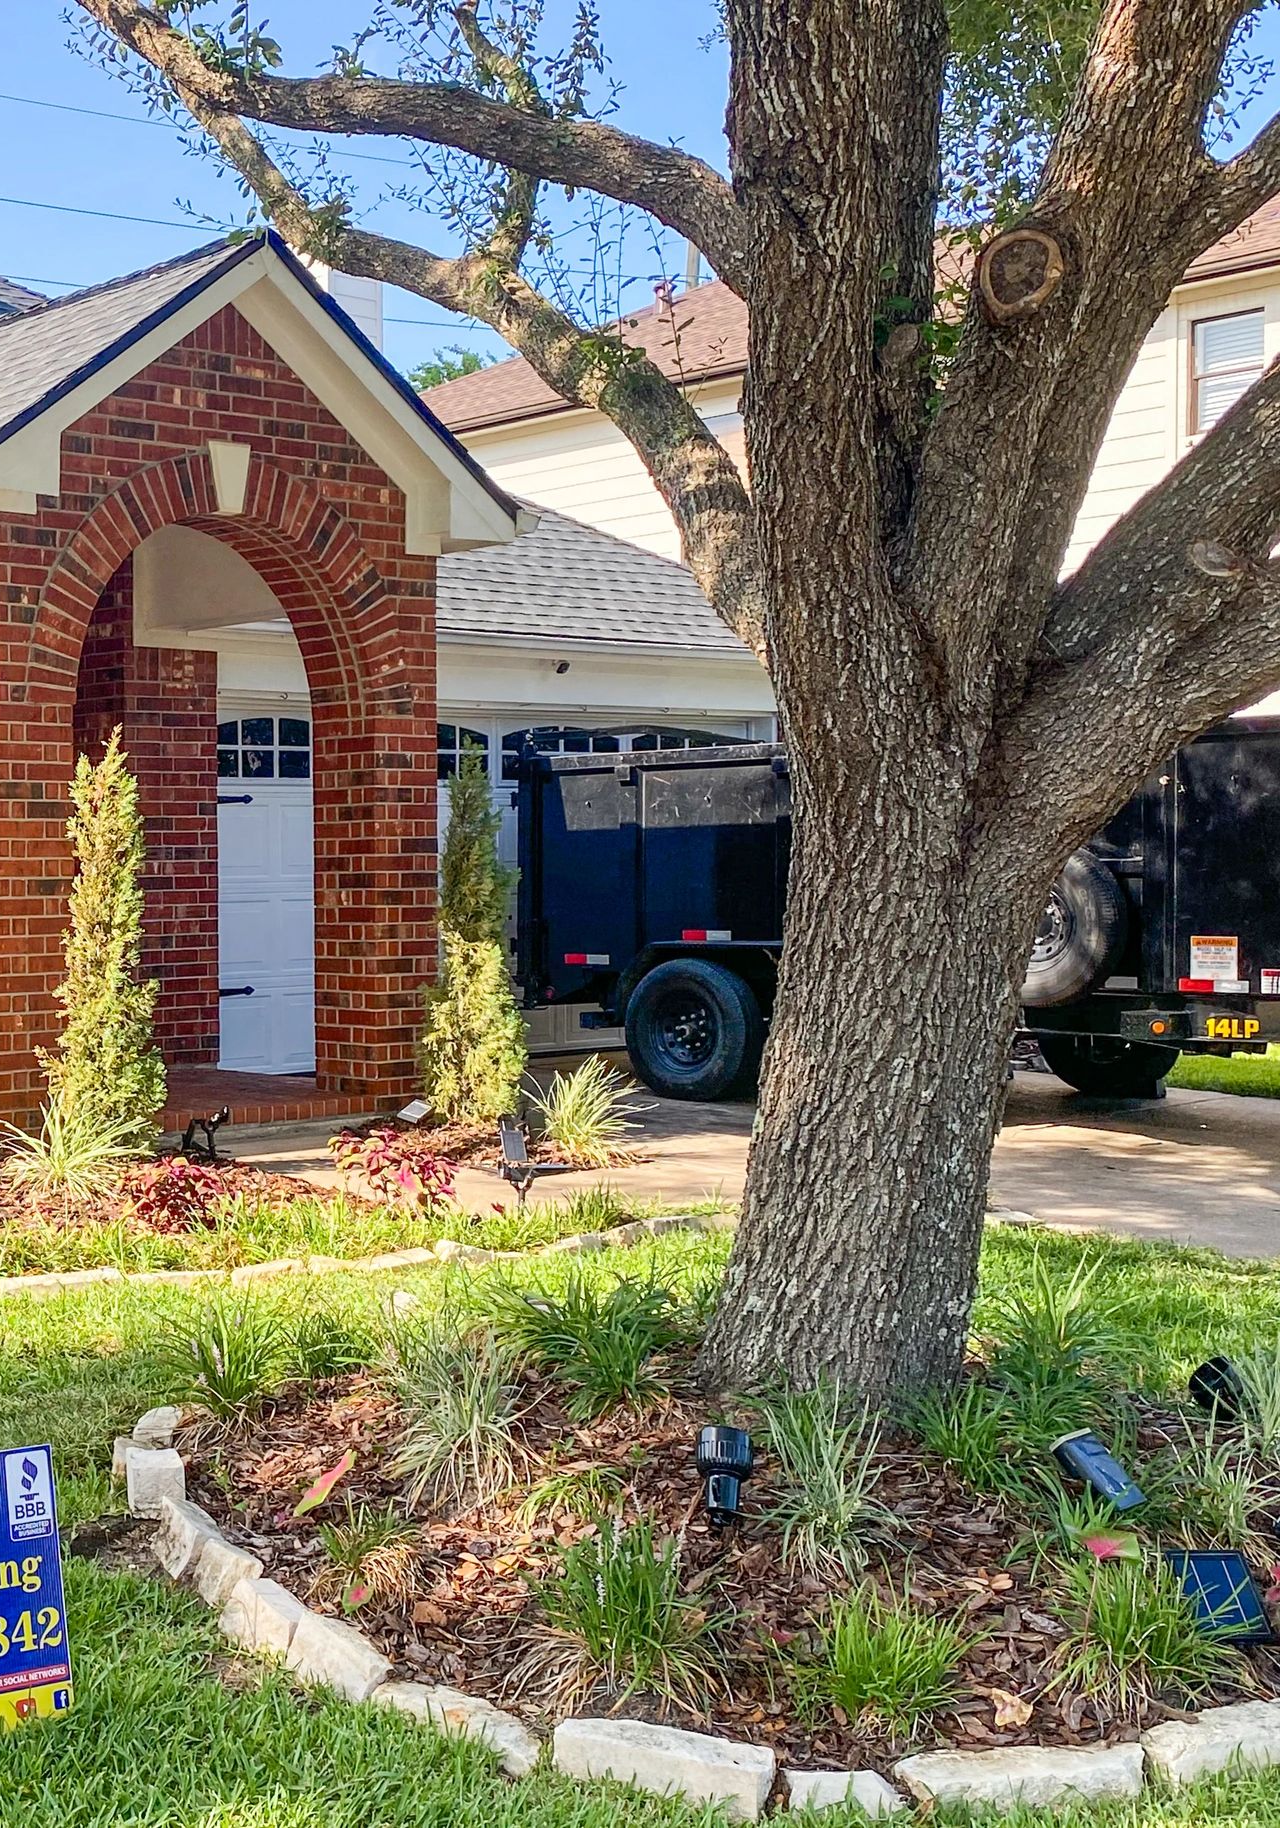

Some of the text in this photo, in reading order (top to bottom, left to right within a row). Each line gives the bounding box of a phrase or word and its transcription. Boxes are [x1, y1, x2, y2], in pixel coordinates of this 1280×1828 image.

[1206, 1018, 1260, 1039] 14LP
[15, 1502, 46, 1519] BBB
[14, 1520, 49, 1531] ACCREDITED
[18, 1528, 47, 1537] BUSINESS
[4, 1675, 28, 1686] SOCIAL
[29, 1667, 66, 1682] NETWORKS
